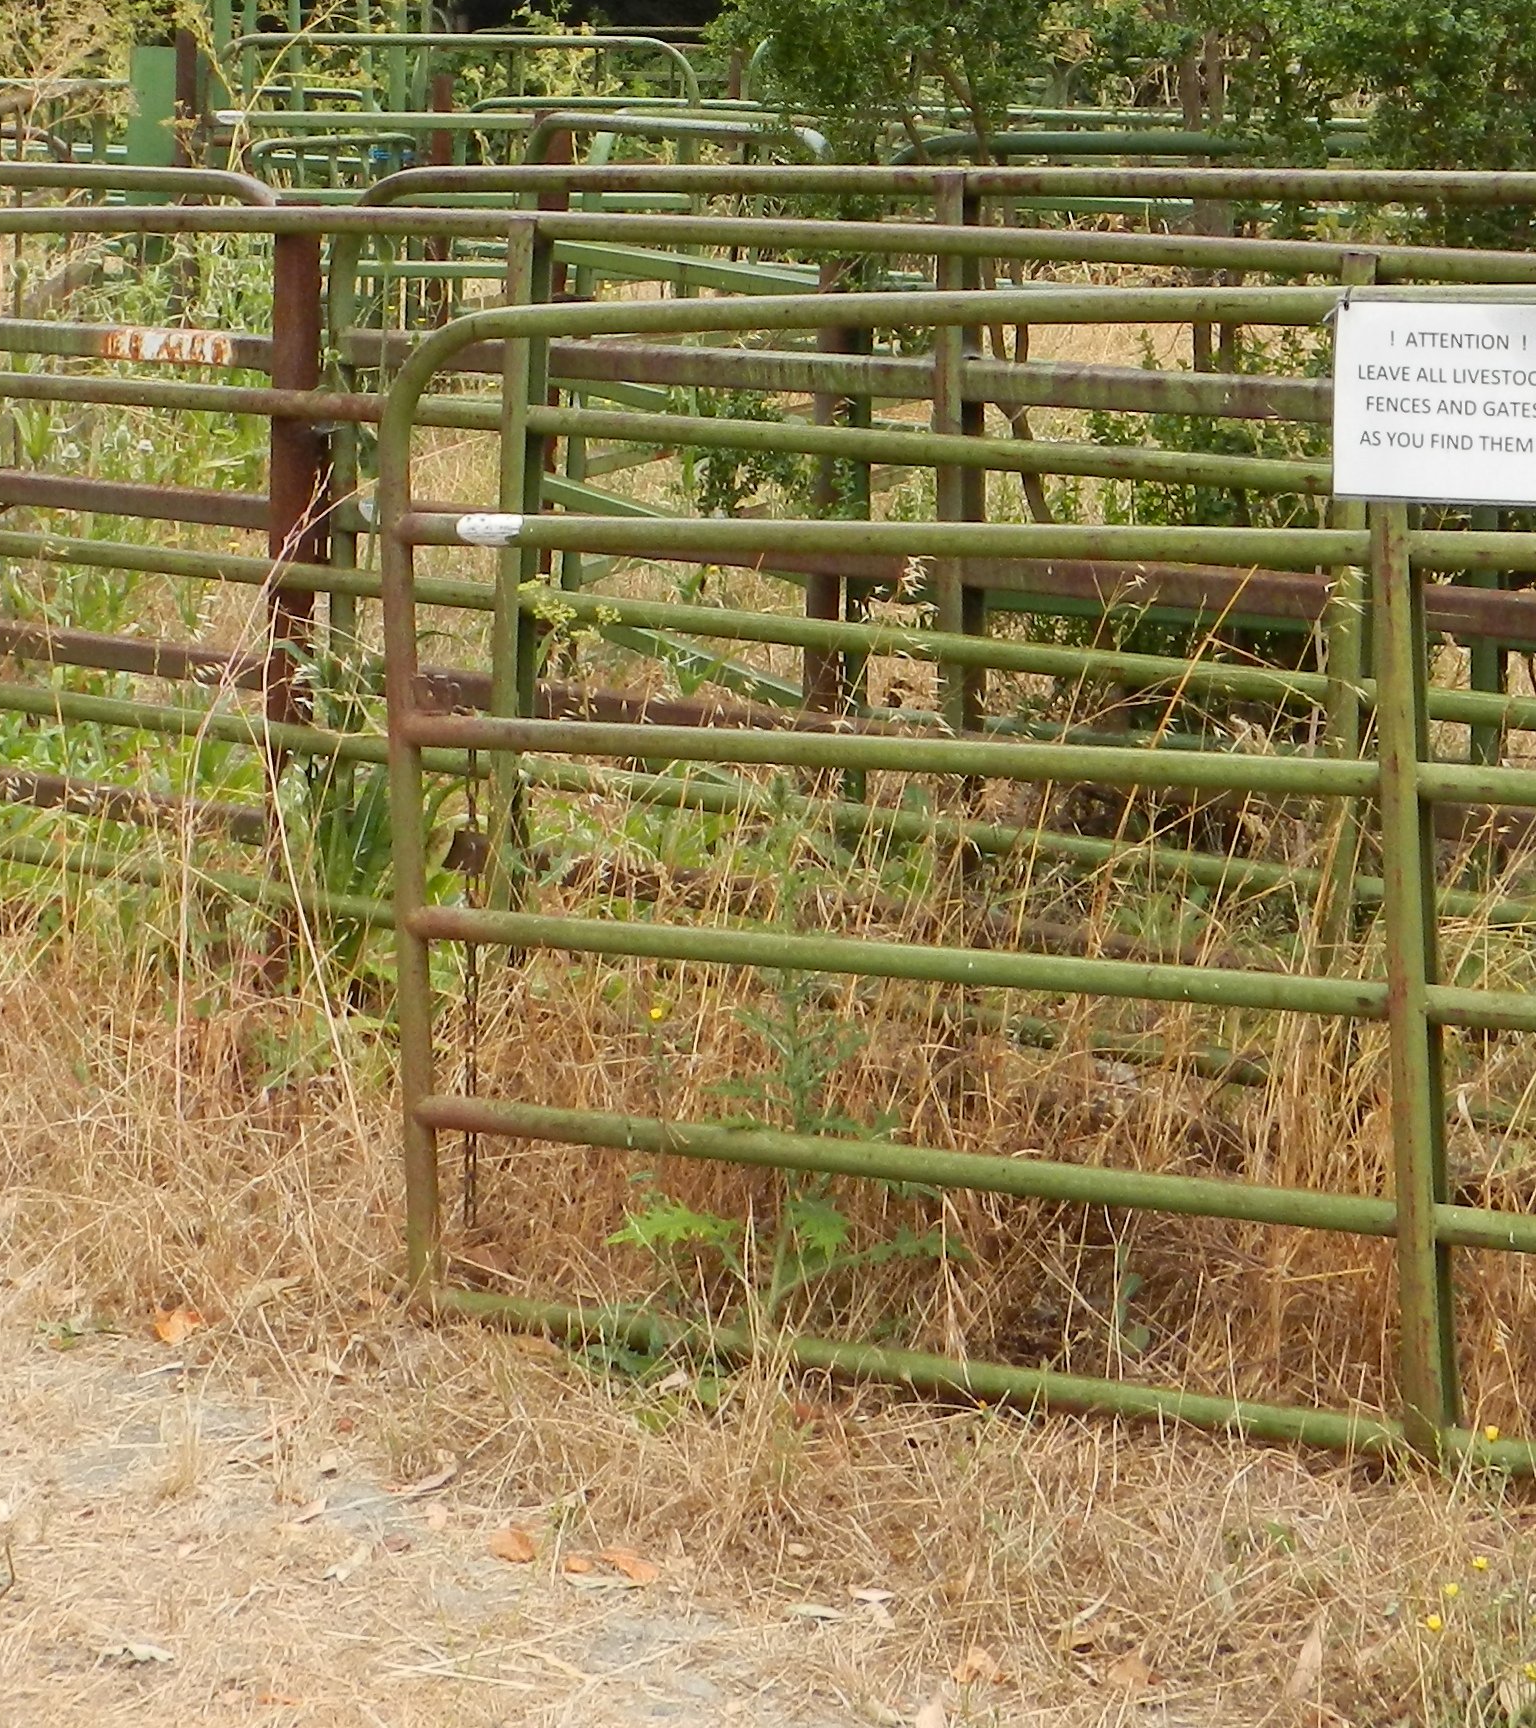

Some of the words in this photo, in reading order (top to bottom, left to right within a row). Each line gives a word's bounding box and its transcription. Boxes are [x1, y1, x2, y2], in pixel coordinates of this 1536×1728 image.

[1405, 331, 1510, 351] ATTENTION
[1358, 364, 1411, 382] LEAVE
[1416, 367, 1448, 384] ALL
[1366, 395, 1432, 415] FENCES
[1436, 399, 1478, 416] AND
[1359, 430, 1382, 447] AS
[1386, 431, 1425, 449] YOU
[1430, 433, 1474, 451] FIND
